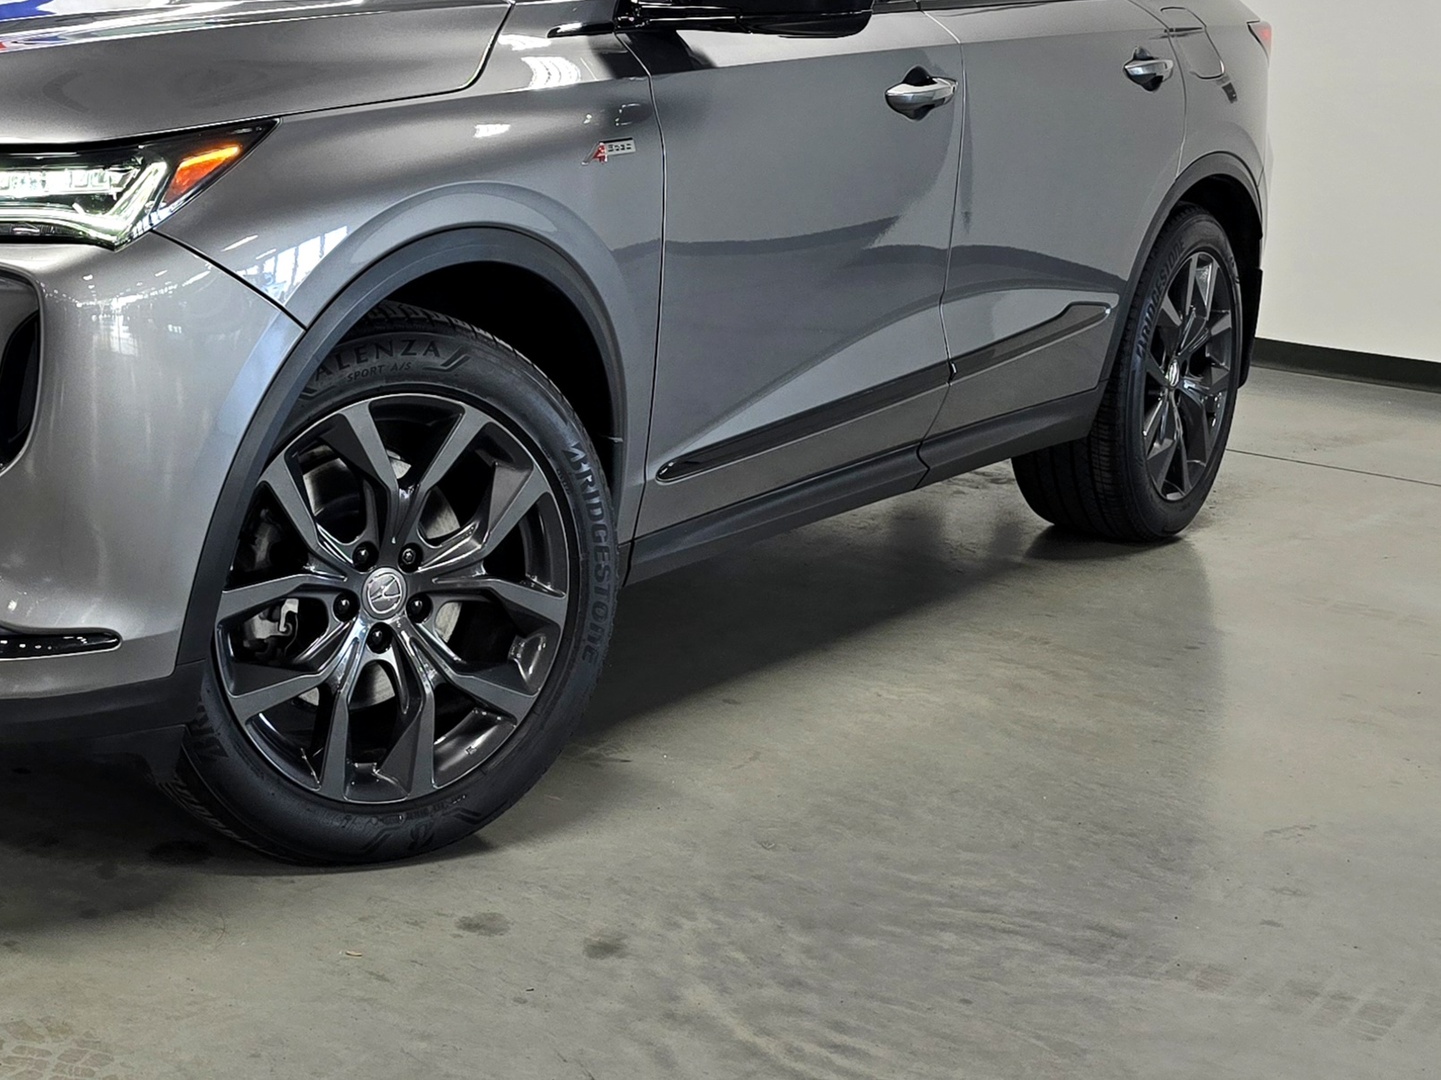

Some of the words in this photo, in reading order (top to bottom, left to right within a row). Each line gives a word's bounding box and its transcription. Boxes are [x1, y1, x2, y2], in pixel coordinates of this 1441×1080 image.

[347, 364, 386, 382] SPORT
[390, 361, 412, 372] A/S
[561, 442, 611, 663] BRIDGESTONE
